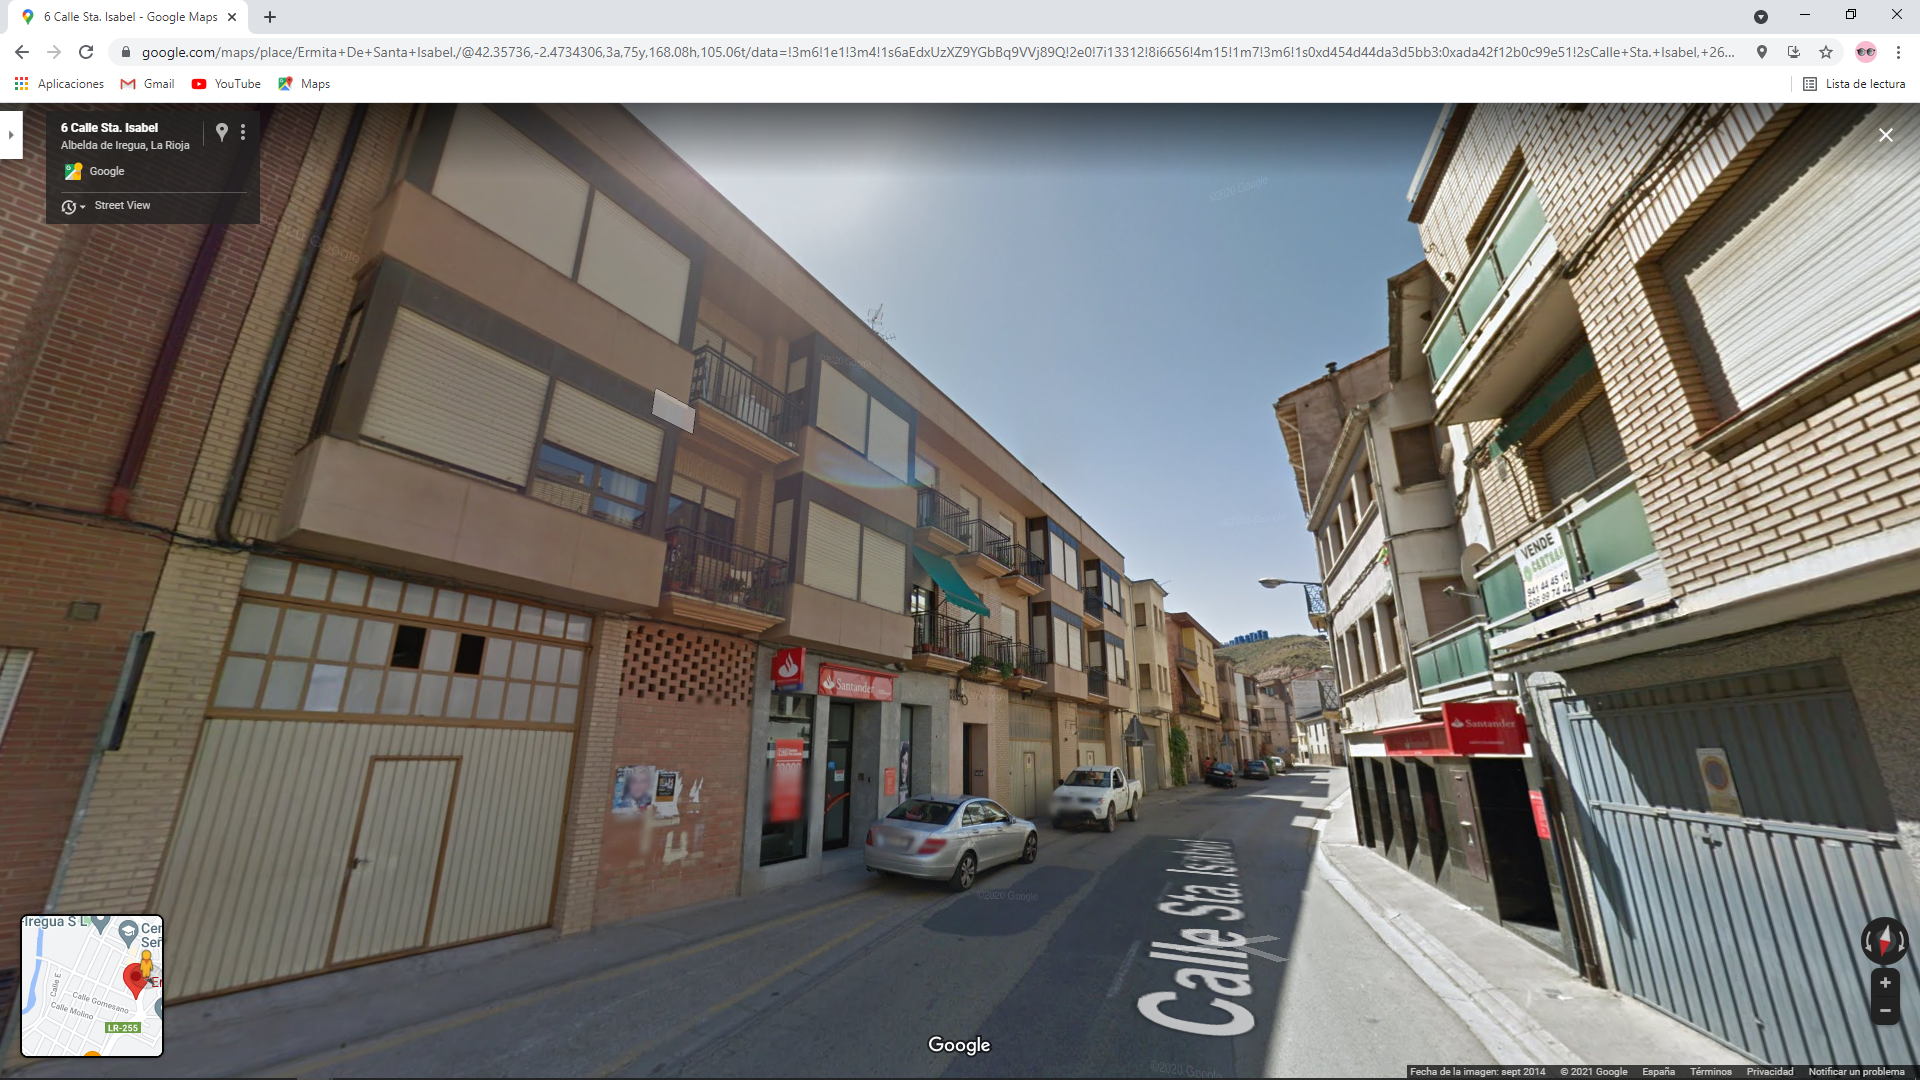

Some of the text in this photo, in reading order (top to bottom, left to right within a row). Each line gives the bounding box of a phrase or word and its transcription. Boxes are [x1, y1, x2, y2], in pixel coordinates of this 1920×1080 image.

[44, 11, 51, 22] 6
[54, 11, 79, 22] Calle
[82, 11, 102, 22] Sta.
[105, 11, 136, 22] Isabel
[146, 11, 185, 25] Google
[189, 11, 218, 25] Maps
[38, 78, 105, 92] Aplicaciones
[143, 78, 175, 89] Gmail
[214, 78, 262, 89] YouTube
[301, 78, 331, 92] Maps
[1826, 78, 1906, 89] Lista de lectura
[1520, 532, 1555, 560] VENDE
[836, 678, 875, 694] Santander
[1465, 718, 1516, 728] Santander
